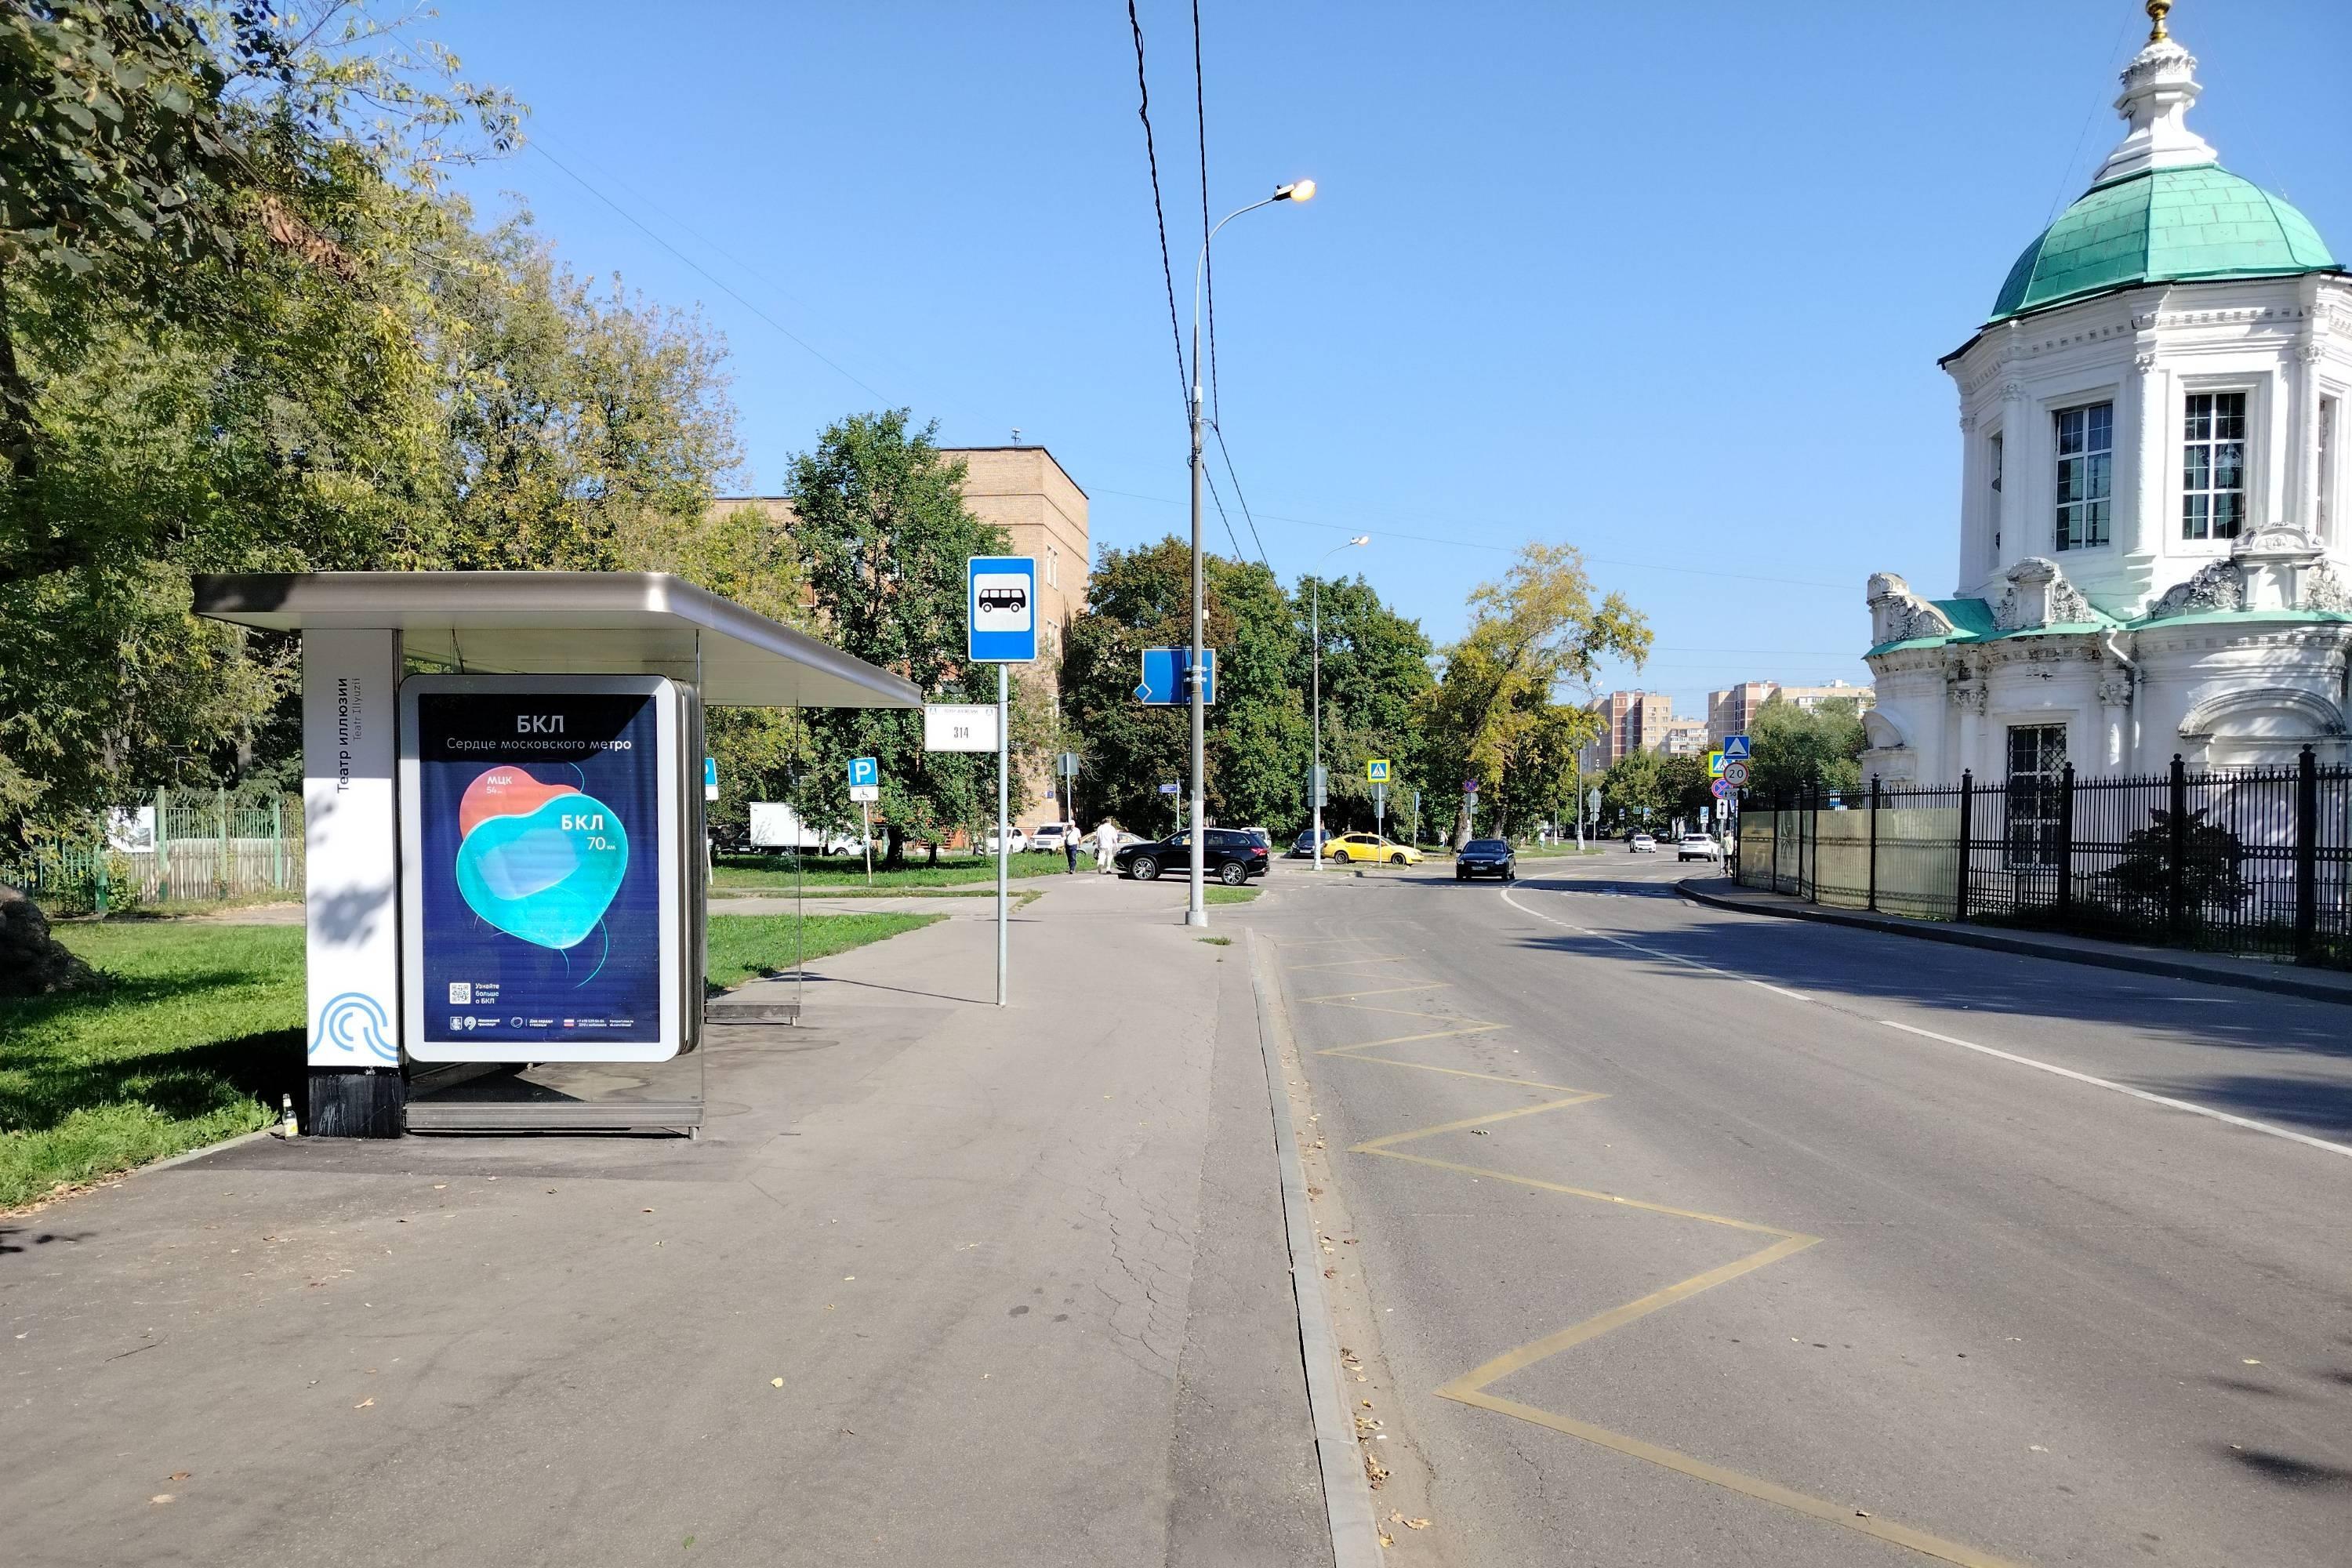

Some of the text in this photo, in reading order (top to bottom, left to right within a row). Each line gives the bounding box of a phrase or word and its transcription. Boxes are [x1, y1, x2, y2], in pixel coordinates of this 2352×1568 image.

[352, 678, 363, 742] Teatr Illyuzii
[517, 715, 564, 733] БКЛ
[337, 678, 351, 793] Театр иллюзии
[953, 726, 969, 739] 314
[447, 737, 632, 752] Сердце московского метро
[487, 775, 513, 786] МЦК
[1729, 769, 1744, 779] 20
[561, 815, 604, 830] БКЛ
[586, 837, 606, 851] 70
